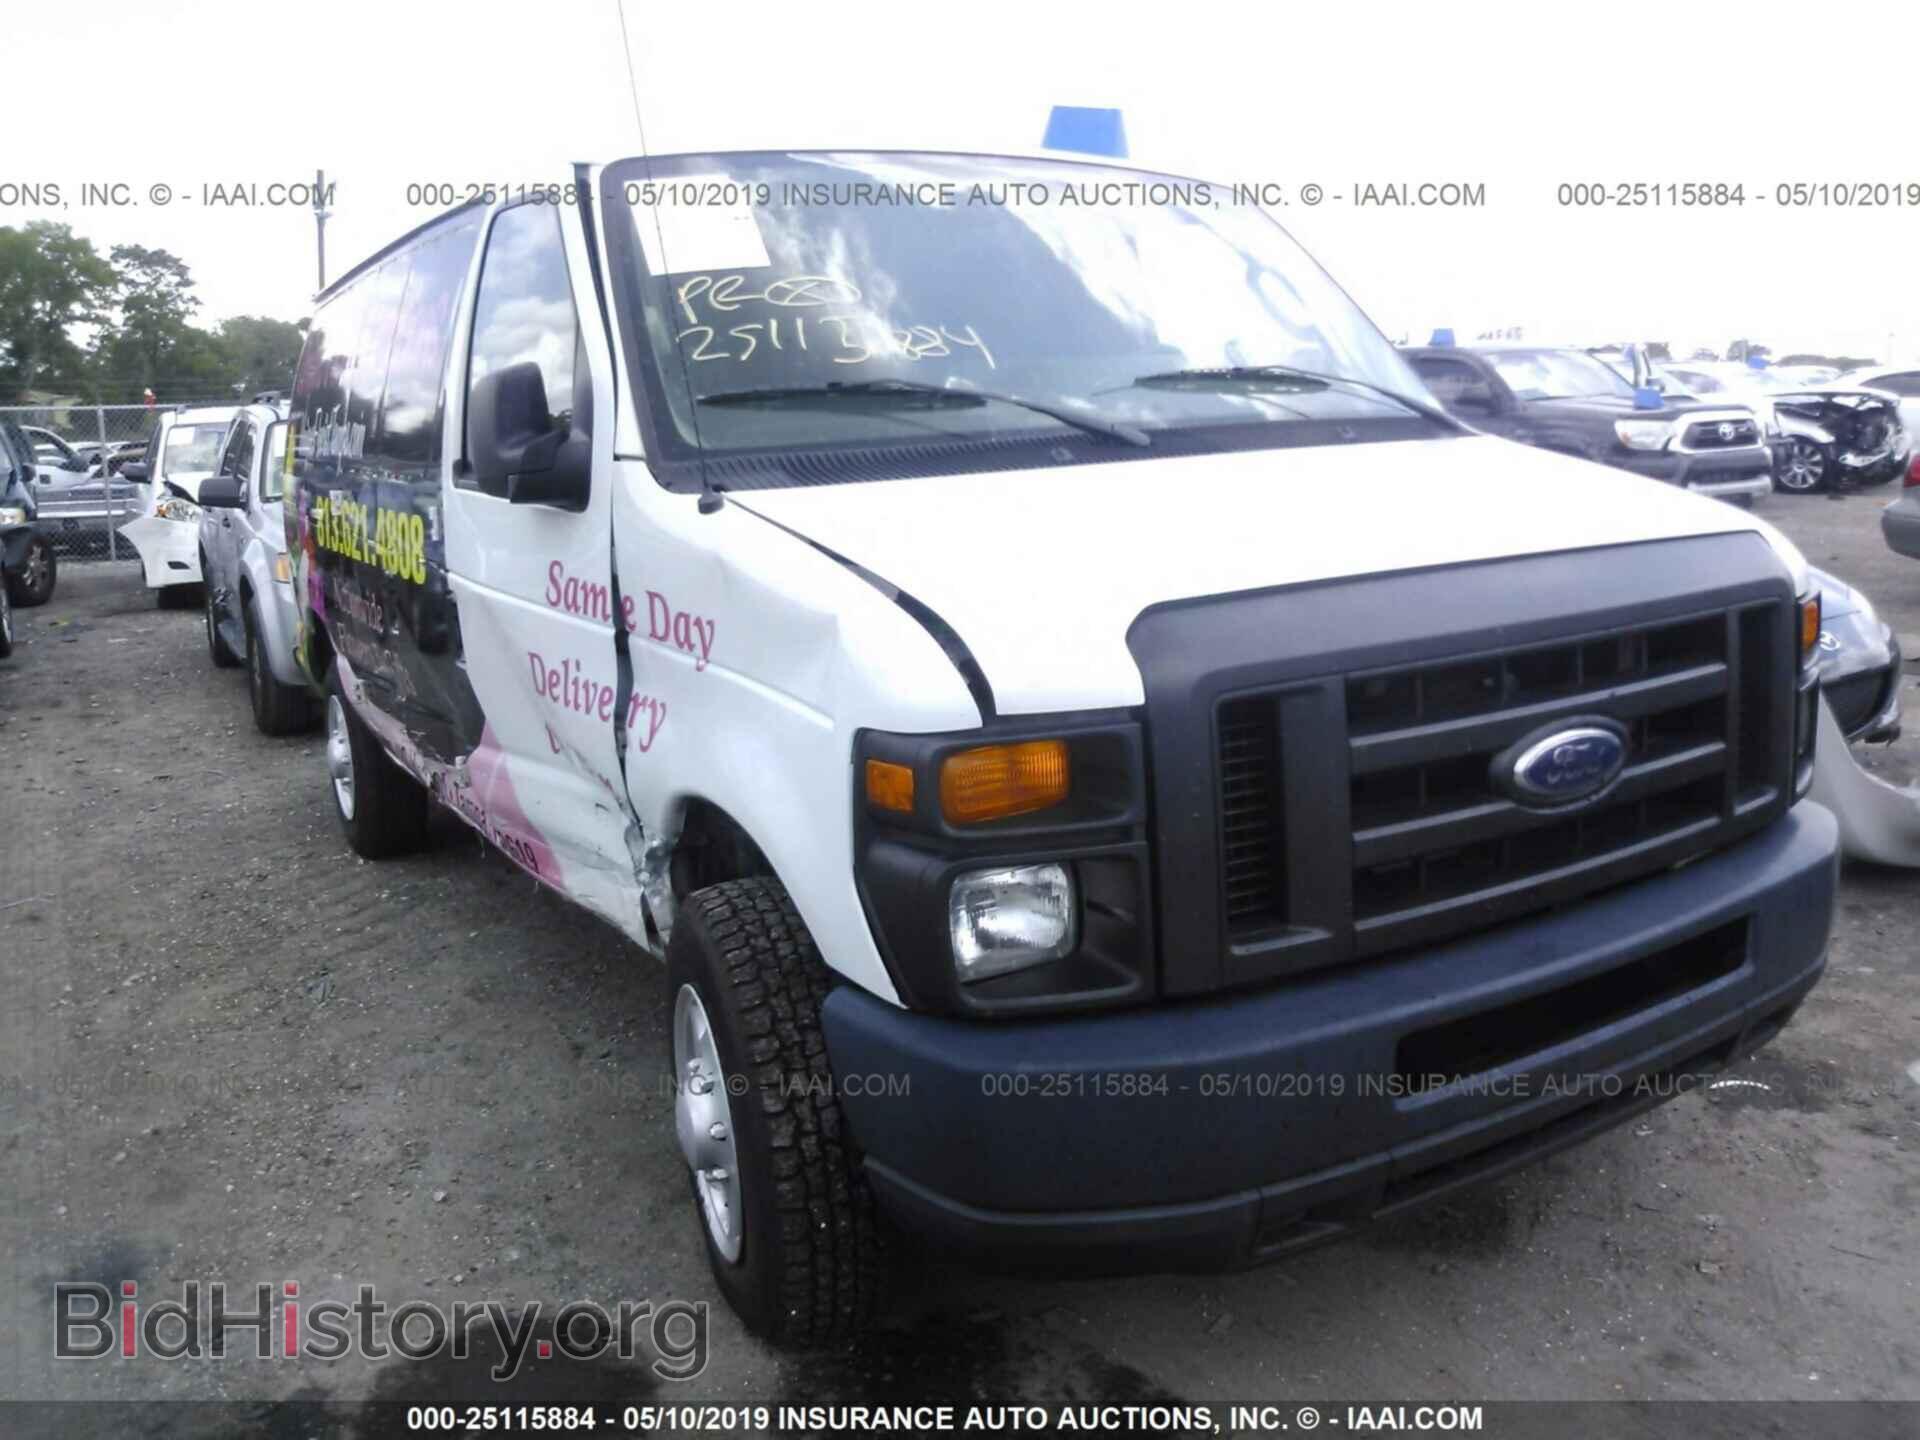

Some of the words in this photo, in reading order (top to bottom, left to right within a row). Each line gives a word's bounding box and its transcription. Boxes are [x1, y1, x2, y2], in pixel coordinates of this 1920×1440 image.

[546, 559, 637, 632] Same
[646, 590, 716, 672] Day
[527, 651, 668, 753] Delivery
